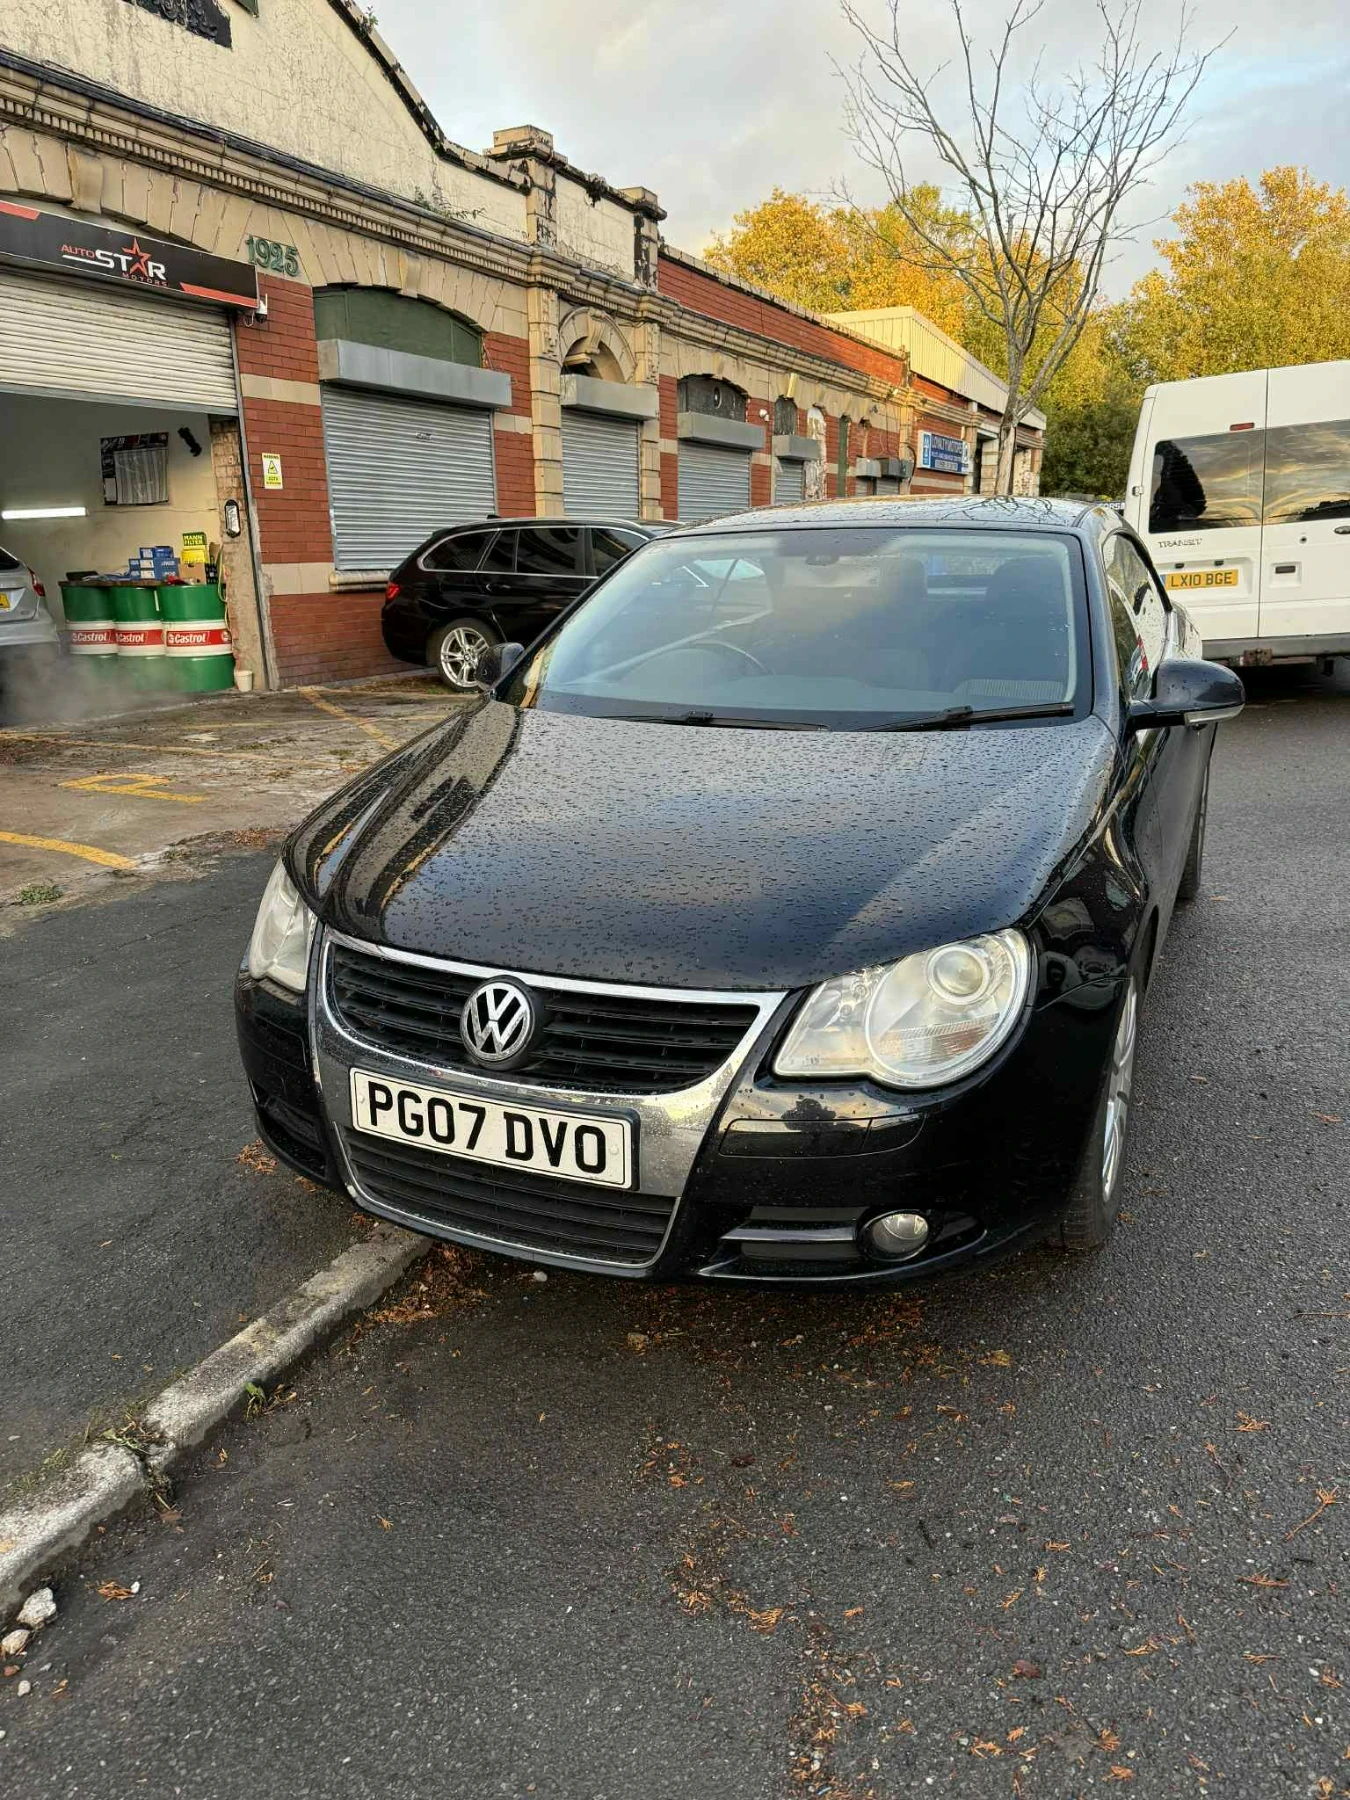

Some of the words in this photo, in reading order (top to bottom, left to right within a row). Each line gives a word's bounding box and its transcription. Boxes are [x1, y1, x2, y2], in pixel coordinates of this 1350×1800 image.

[61, 244, 95, 259] AUTO
[245, 234, 299, 277] 1925
[121, 272, 168, 287] MOTORS
[1171, 574, 1202, 588] LX10
[1206, 571, 1233, 586] BGE
[77, 632, 108, 642] Castrol
[119, 633, 145, 643] Castrol
[175, 633, 206, 643] Castrol
[368, 1081, 486, 1151] PG07
[503, 1111, 606, 1174] DVO
